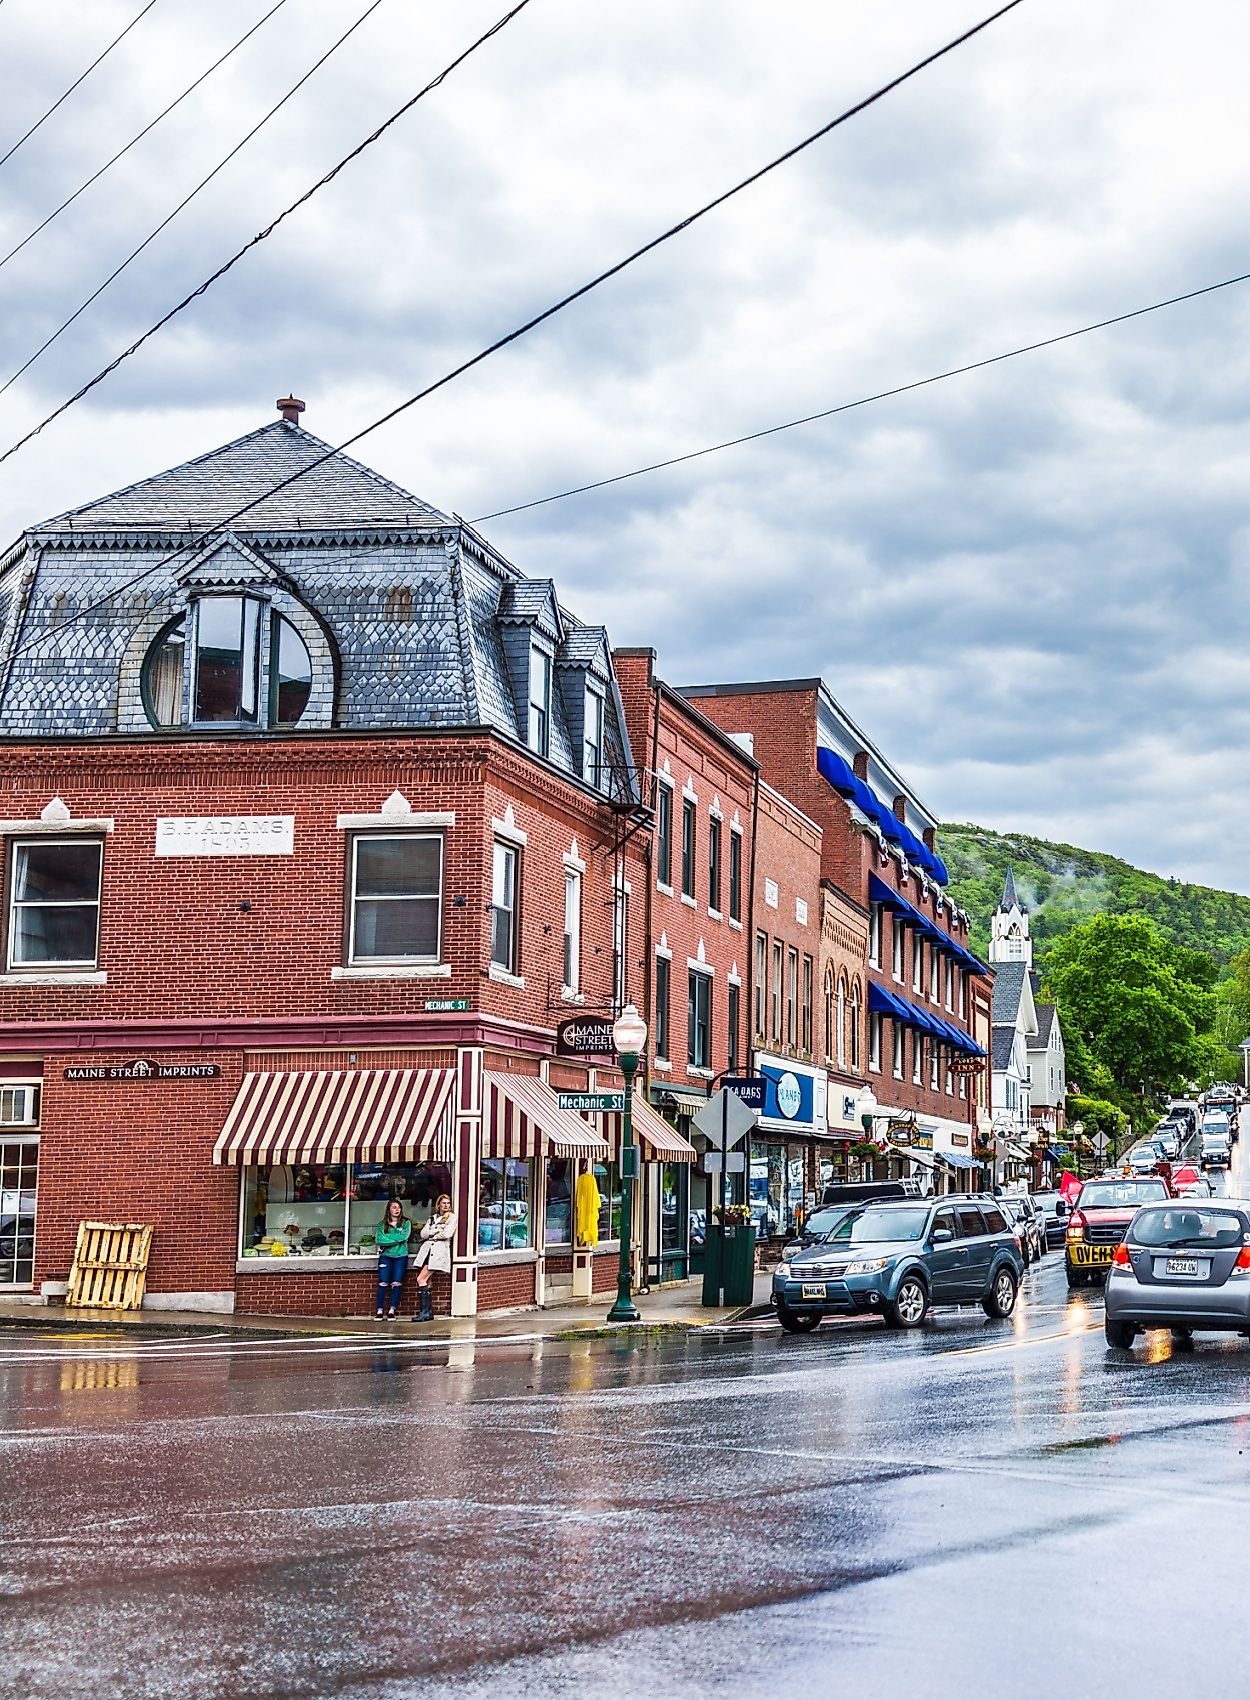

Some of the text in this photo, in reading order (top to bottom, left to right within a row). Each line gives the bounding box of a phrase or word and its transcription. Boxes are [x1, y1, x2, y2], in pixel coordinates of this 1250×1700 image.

[425, 1000, 467, 1010] MECHANIC ST
[576, 1025, 613, 1035] MAINE
[575, 1035, 613, 1045] STREET
[67, 1066, 215, 1078] MAINE STREET IMPRINTS
[560, 1095, 622, 1109] Mechanic St
